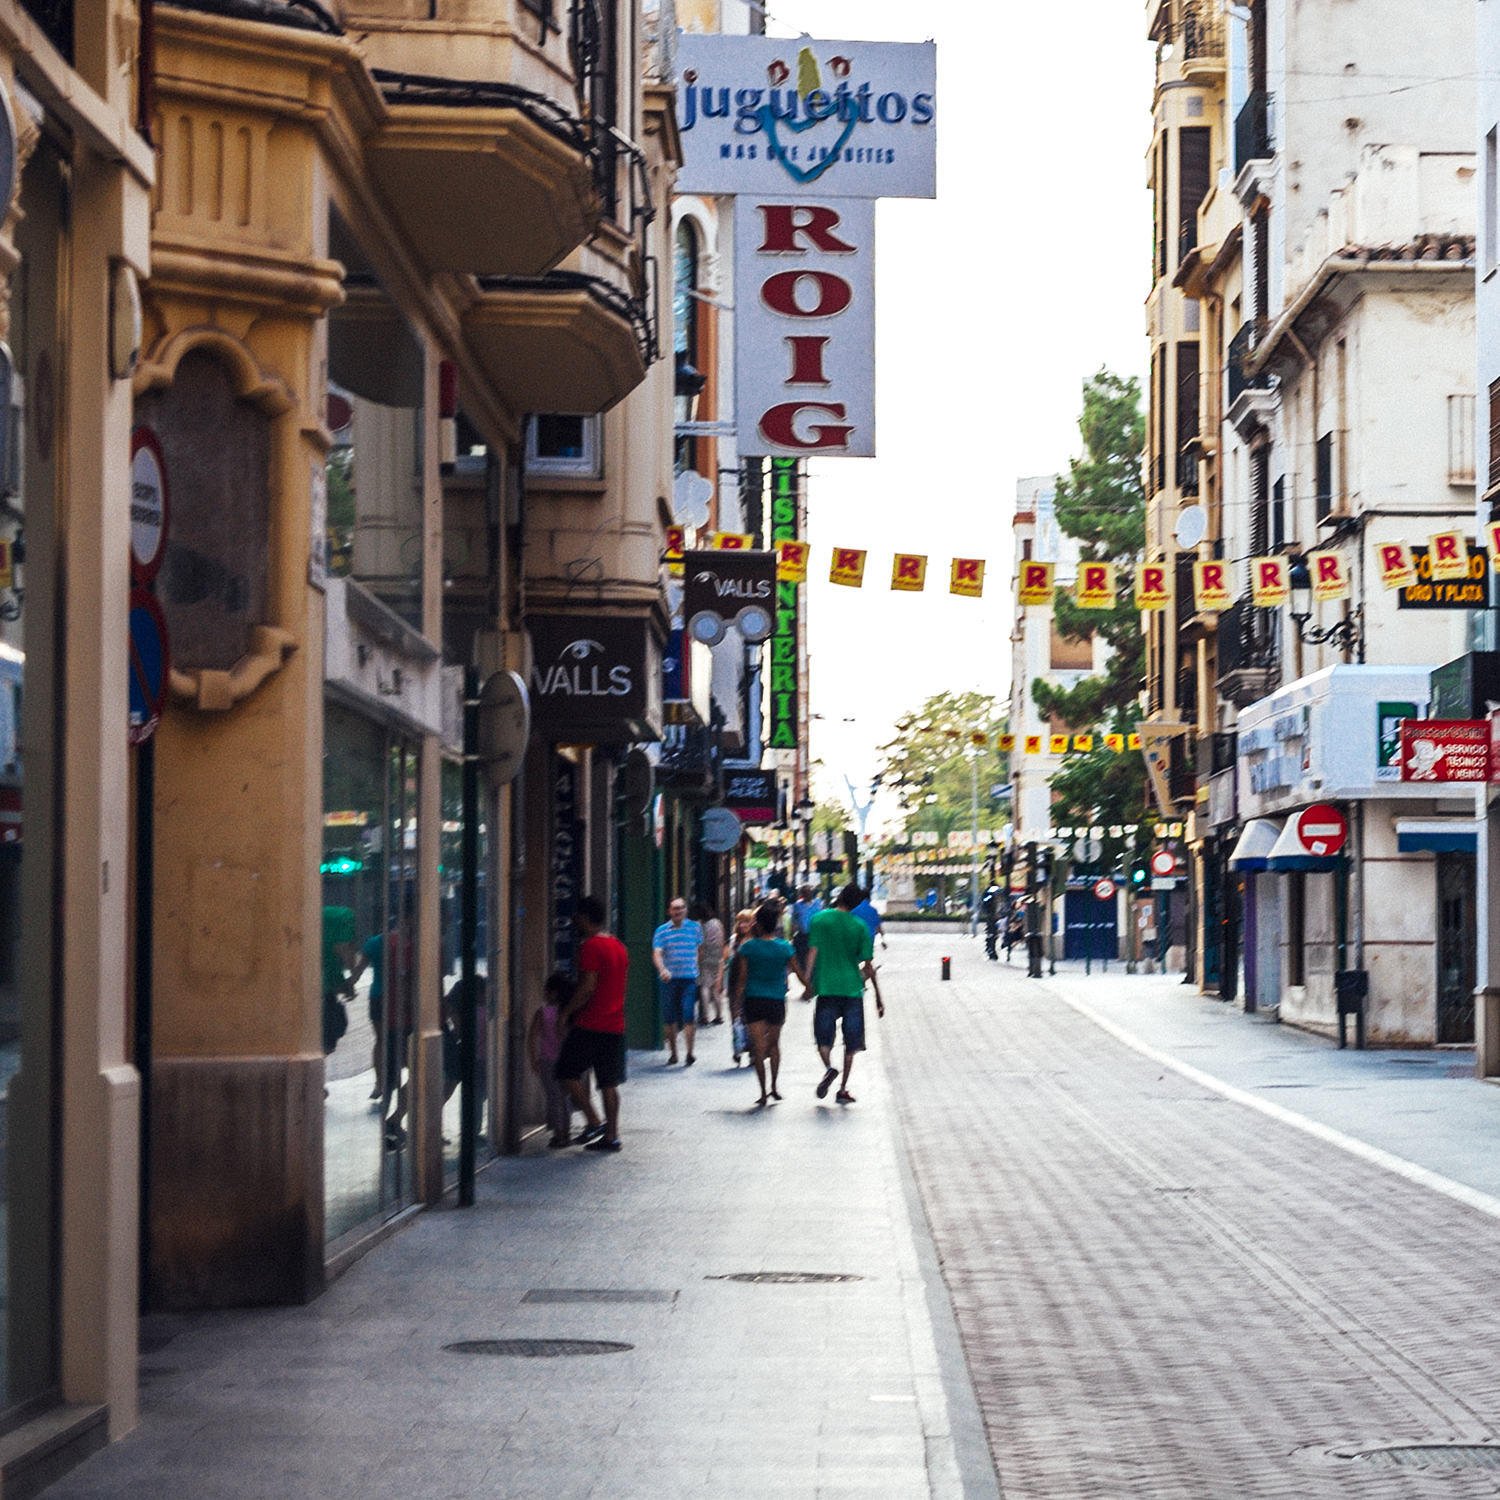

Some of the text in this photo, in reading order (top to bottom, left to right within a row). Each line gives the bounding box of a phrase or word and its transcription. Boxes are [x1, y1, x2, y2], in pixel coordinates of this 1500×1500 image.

[680, 66, 935, 135] juguettos
[756, 203, 858, 450] ROIG
[1381, 545, 1406, 572] R
[1436, 536, 1459, 561] R
[1026, 566, 1047, 588] R
[1086, 567, 1107, 591] R
[1144, 568, 1165, 593] R
[1202, 565, 1224, 590] R
[1260, 562, 1281, 588] R
[1318, 556, 1340, 583] R
[713, 578, 771, 598] VALLS
[532, 664, 632, 696] VALLS
